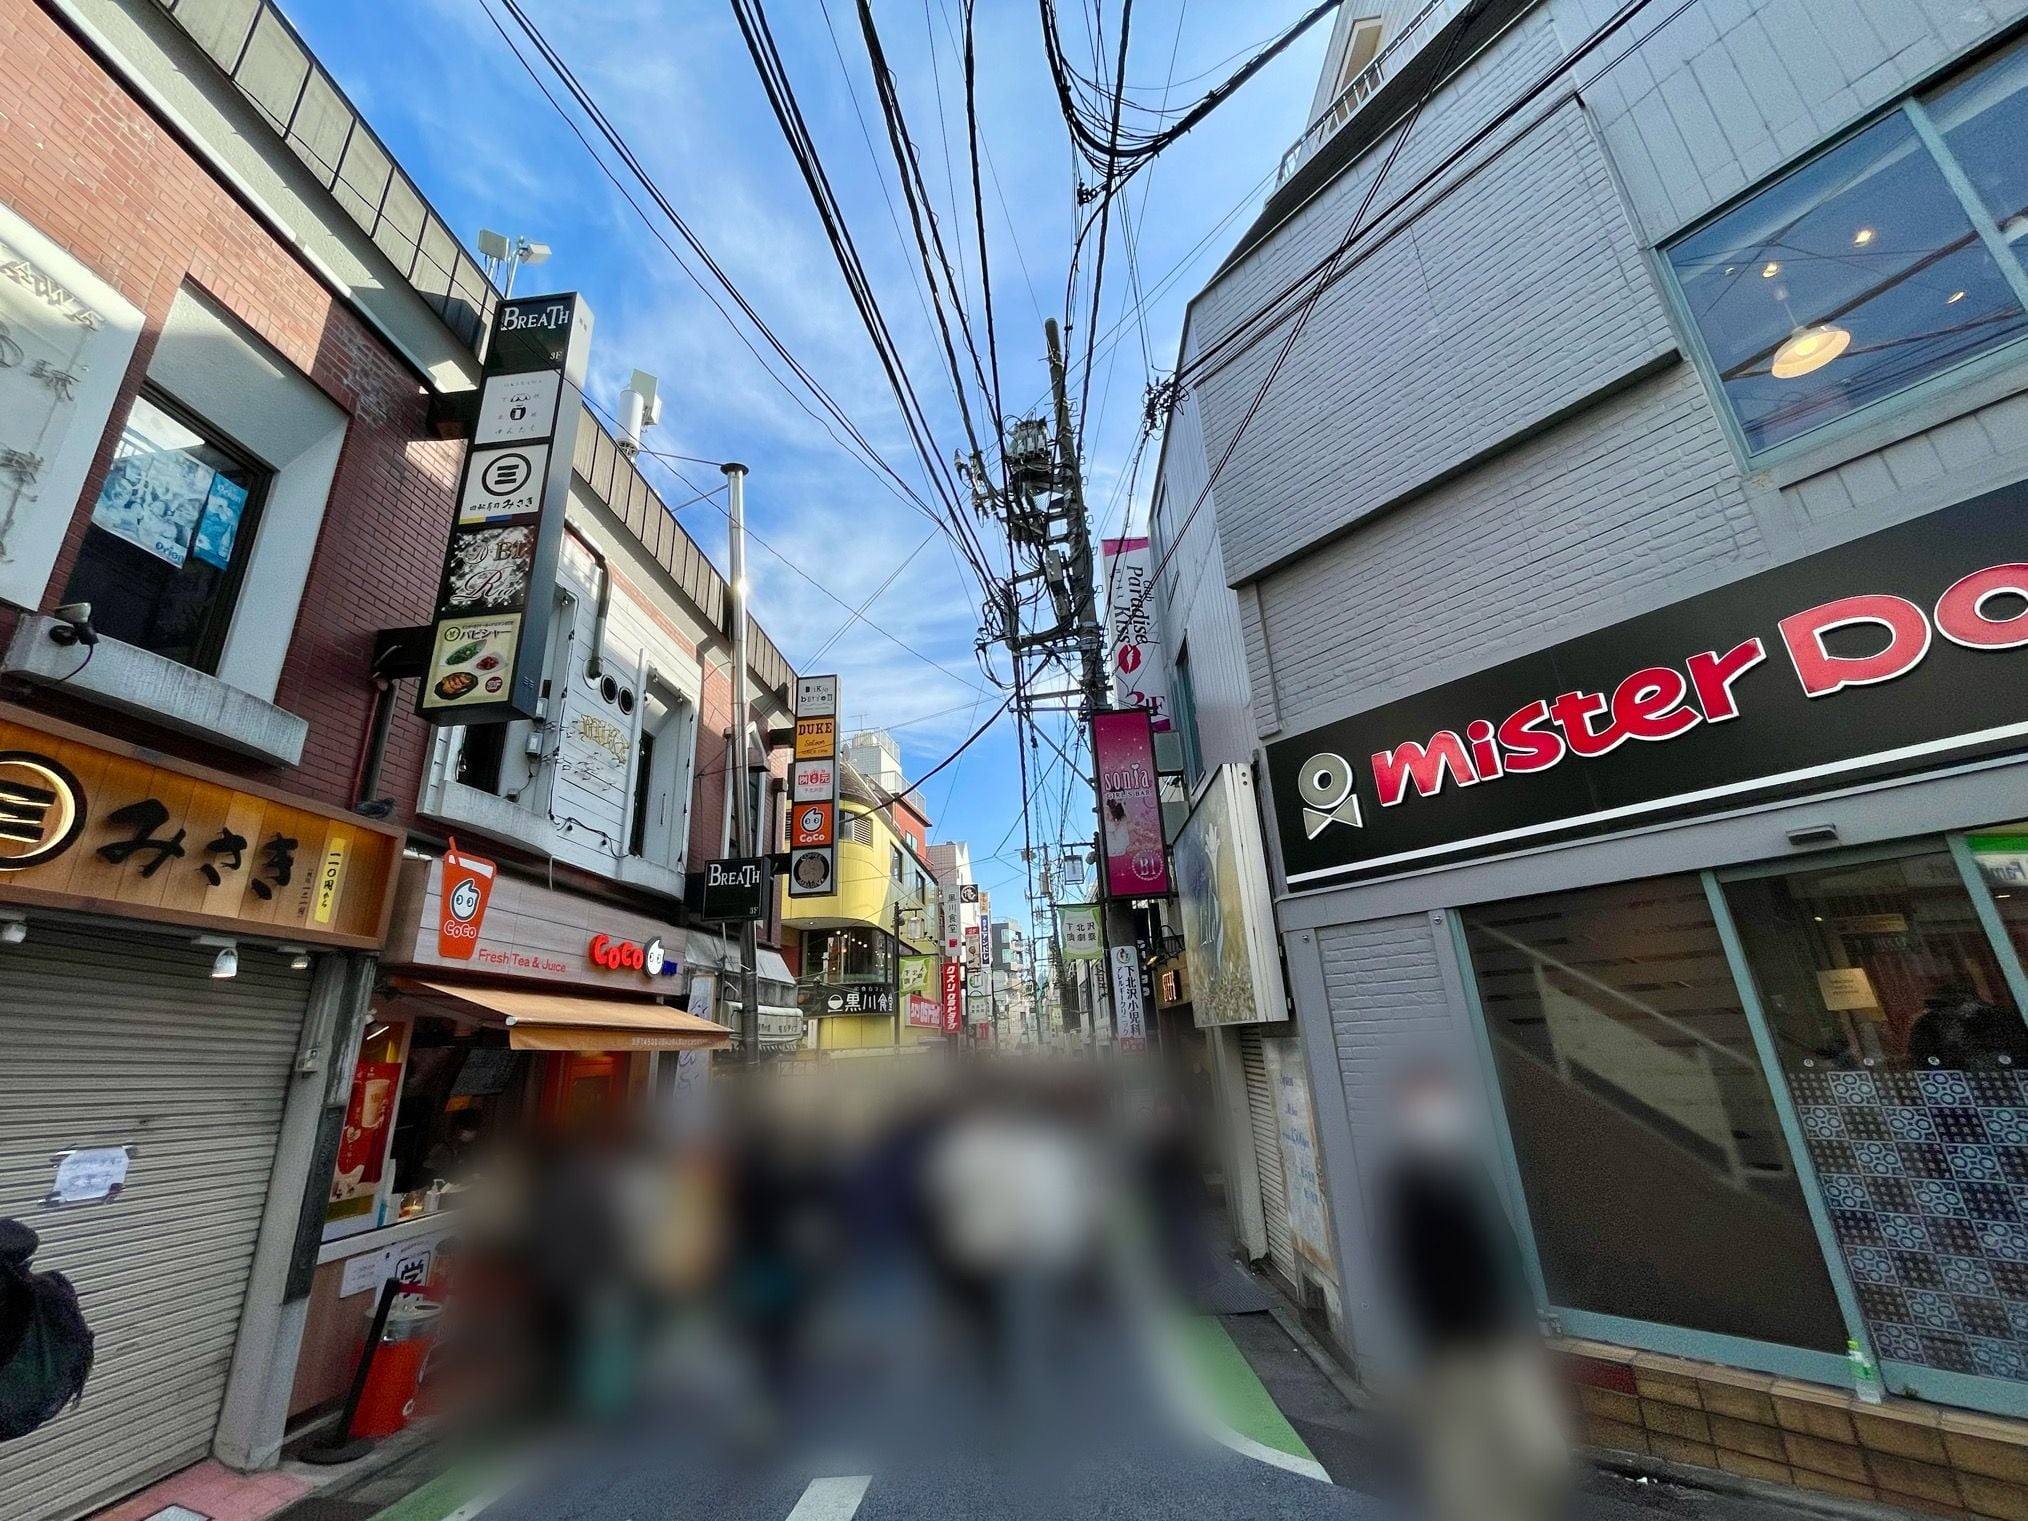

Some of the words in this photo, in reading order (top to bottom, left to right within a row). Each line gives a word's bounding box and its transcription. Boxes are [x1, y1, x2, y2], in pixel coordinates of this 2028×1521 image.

[500, 305, 570, 331] BREATH
[798, 722, 832, 736] DUKE
[1372, 637, 1768, 807] mister
[1104, 763, 1151, 791] sonia
[1135, 789, 1151, 797] BAR
[97, 797, 299, 901] みさき
[708, 863, 761, 887] BREATH
[443, 920, 477, 939] CoCo
[478, 949, 510, 965] Fresh
[511, 952, 531, 968] Tea
[531, 957, 540, 968] &
[541, 959, 567, 974] Juice
[589, 933, 644, 970] CoCo
